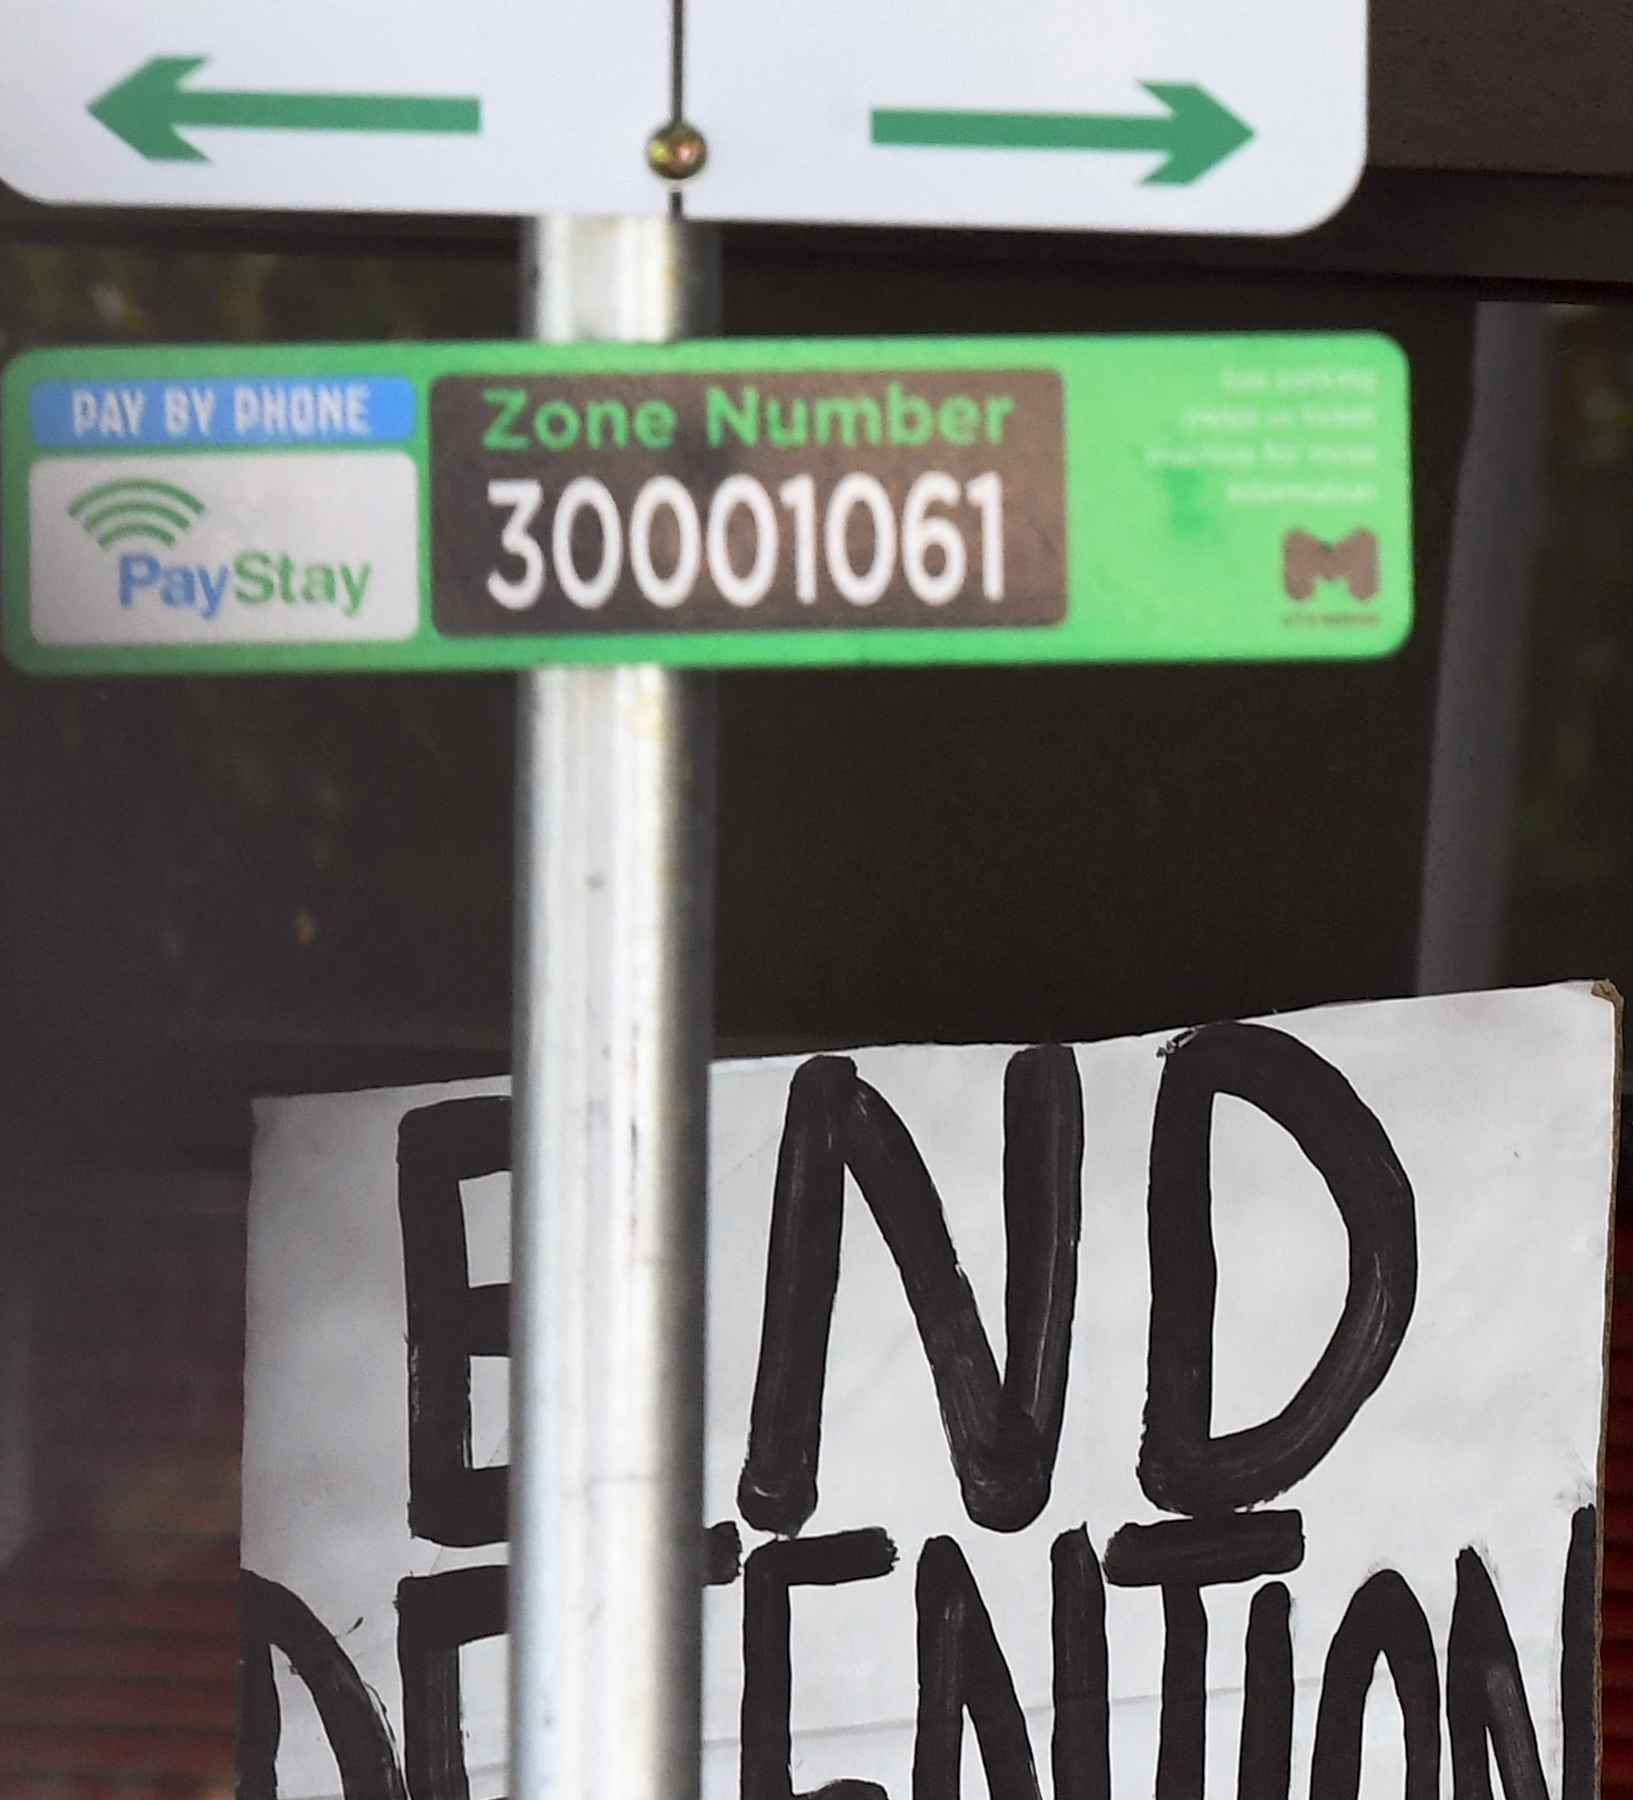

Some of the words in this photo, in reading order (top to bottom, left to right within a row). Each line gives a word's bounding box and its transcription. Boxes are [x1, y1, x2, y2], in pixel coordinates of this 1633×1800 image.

[72, 388, 146, 438] PAY
[164, 386, 216, 436] BY
[234, 384, 371, 436] PHONE
[482, 387, 678, 451] Zone
[704, 382, 1016, 448] Number
[486, 470, 1006, 611] 30001061
[118, 548, 371, 620] PayStay
